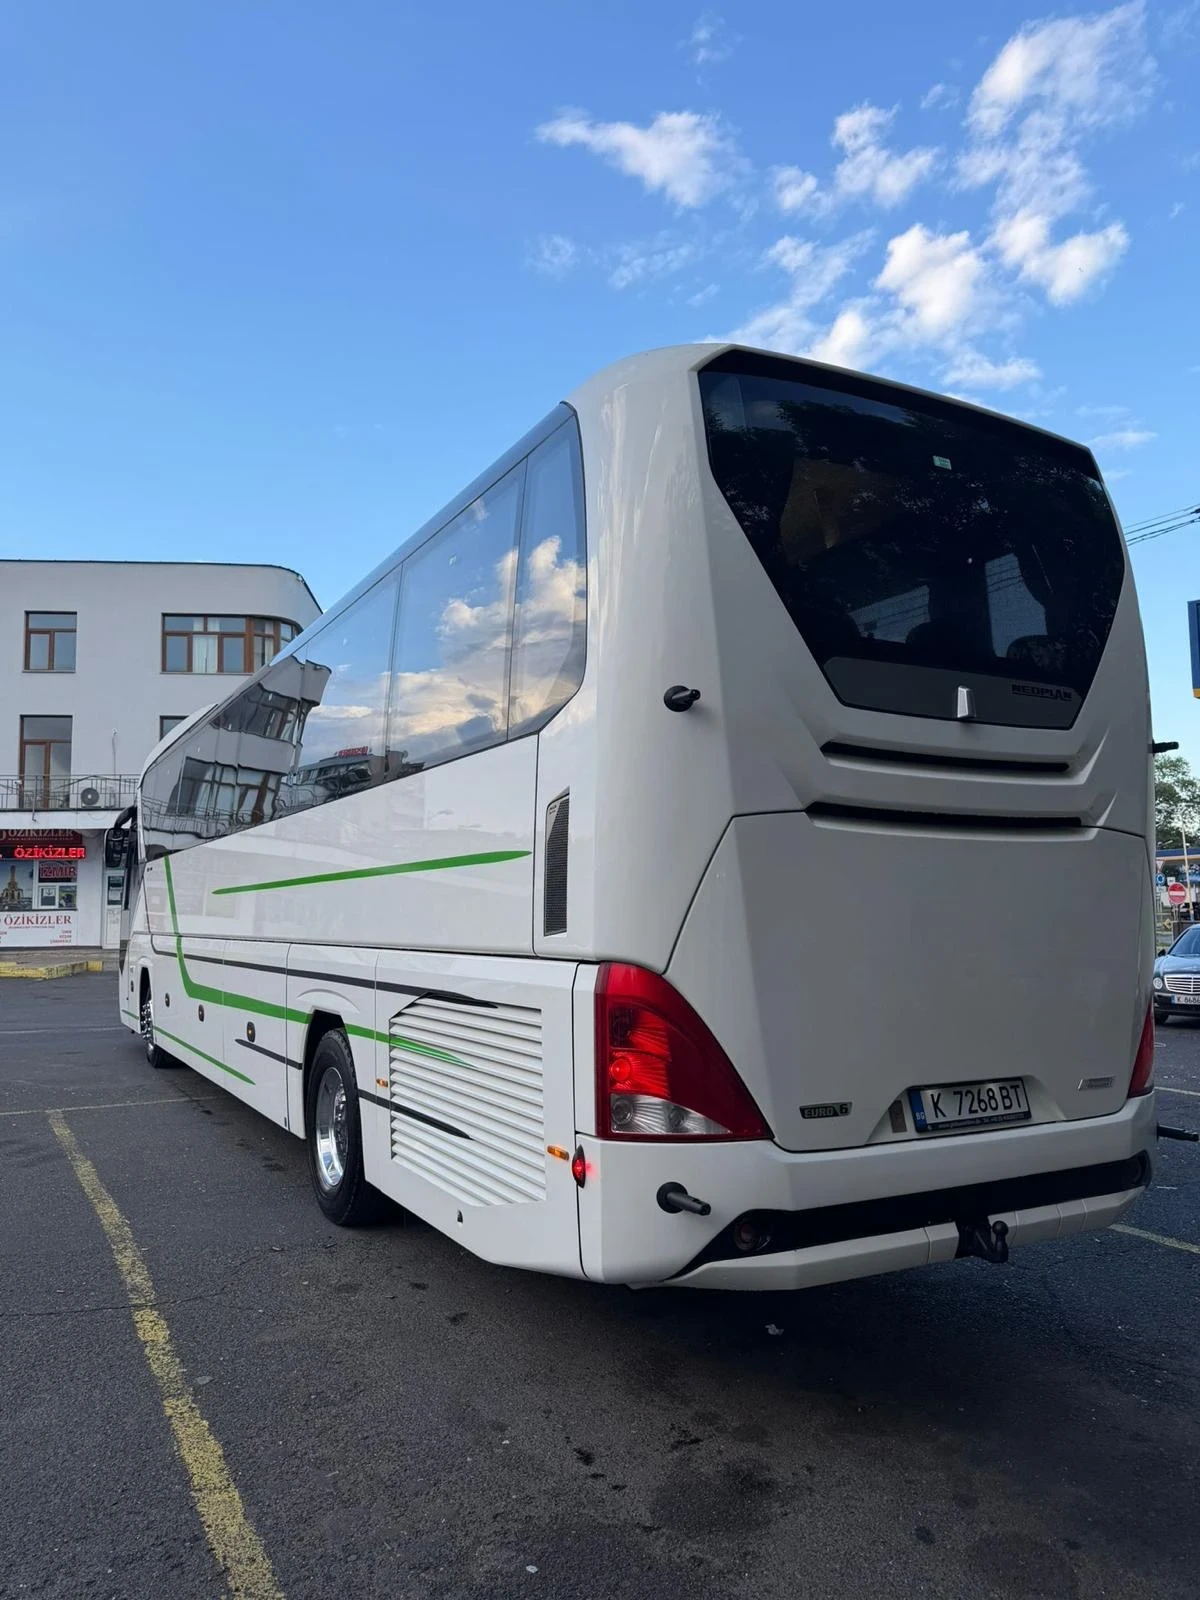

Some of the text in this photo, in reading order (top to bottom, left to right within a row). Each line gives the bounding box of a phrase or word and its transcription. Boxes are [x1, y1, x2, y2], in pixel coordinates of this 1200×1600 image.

[1011, 684, 1073, 702] NEOPLAN
[4, 914, 72, 925] ÖZİKİZLER
[804, 1103, 849, 1117] EURO 6
[931, 1093, 946, 1118] K
